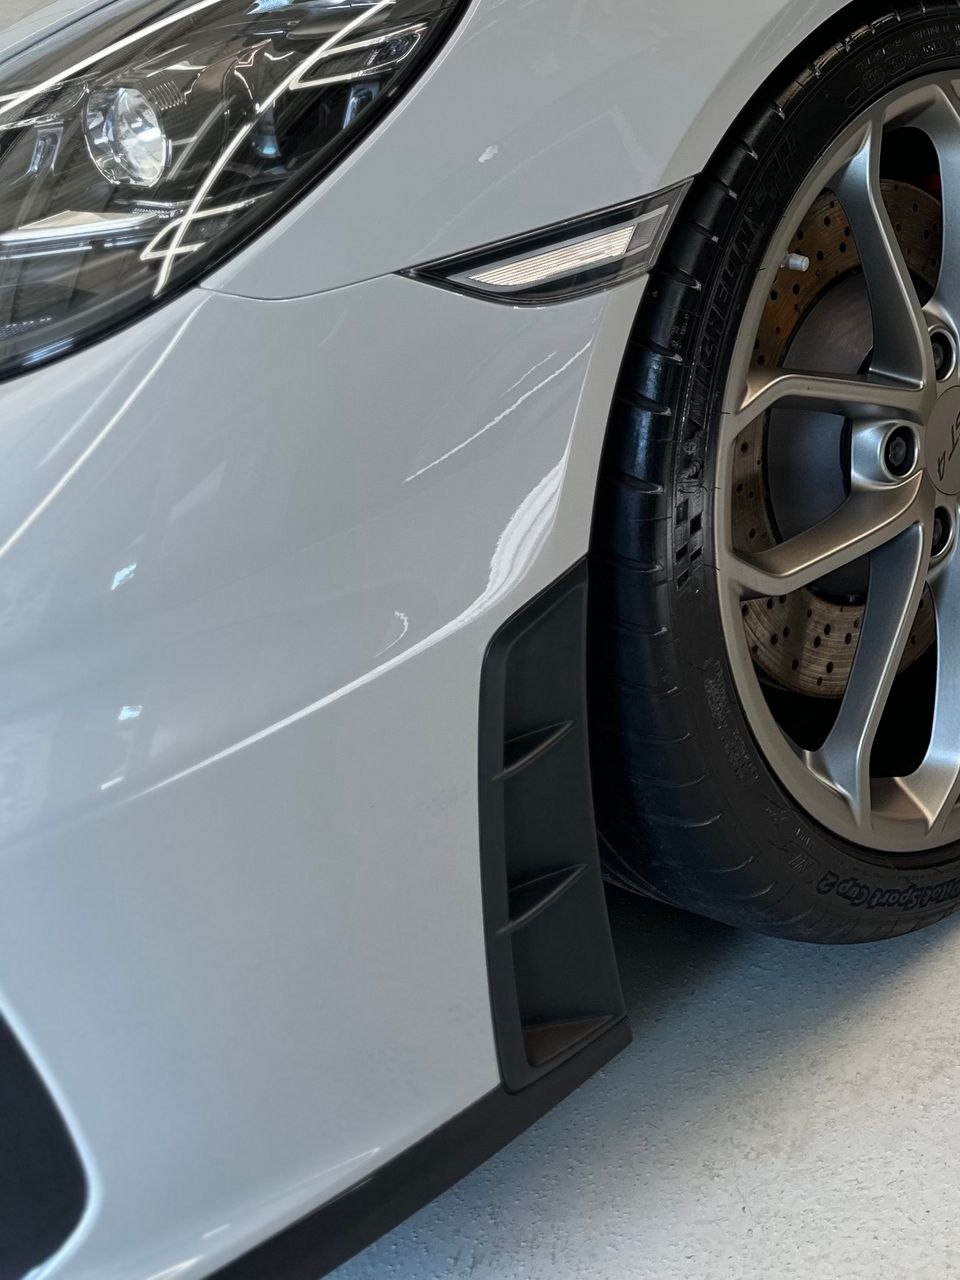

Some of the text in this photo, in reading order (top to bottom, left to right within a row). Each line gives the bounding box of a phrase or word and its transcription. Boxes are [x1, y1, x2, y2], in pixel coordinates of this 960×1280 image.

[816, 871, 839, 895] 2
[836, 877, 871, 907] Cup
[868, 884, 923, 911] Sport
